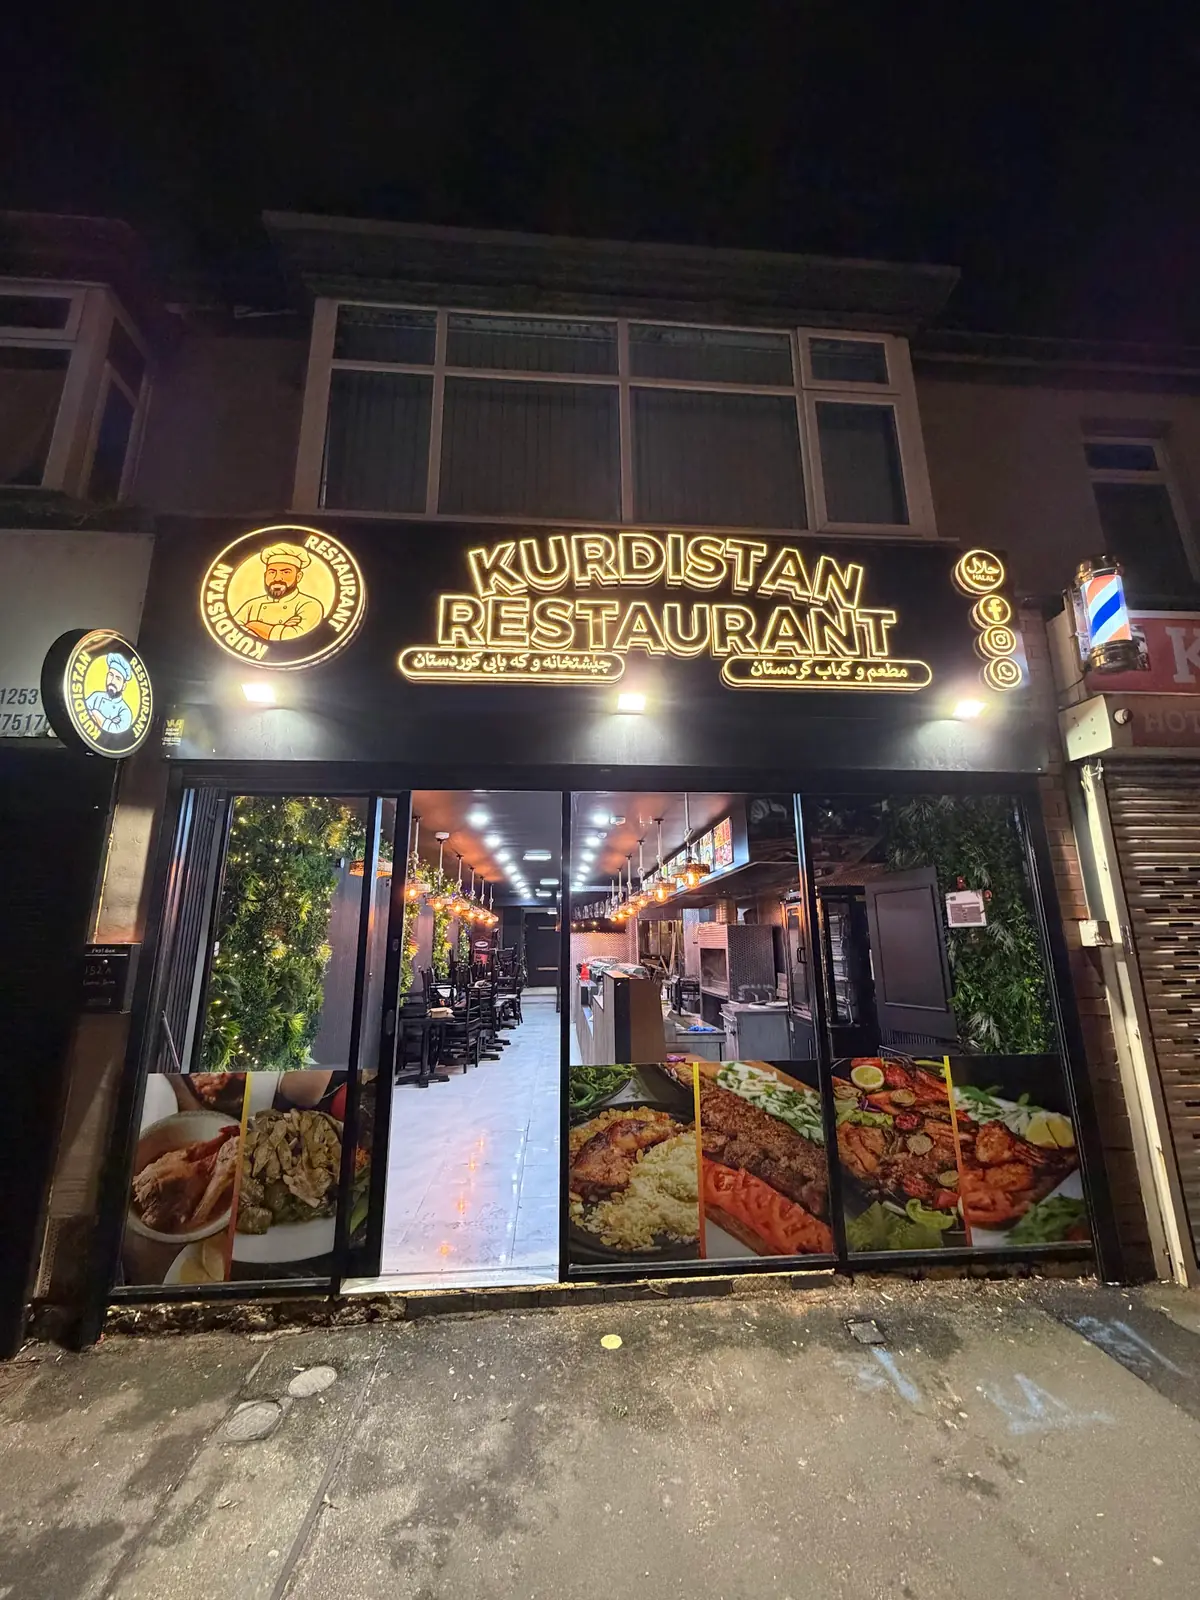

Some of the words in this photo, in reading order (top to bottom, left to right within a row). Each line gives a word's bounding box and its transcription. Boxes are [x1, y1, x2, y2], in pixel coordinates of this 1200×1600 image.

[304, 534, 357, 633] RESTAURANT
[468, 532, 864, 609] KURDISTAN
[966, 557, 1000, 574] حلال
[972, 574, 996, 583] HALAL
[206, 563, 270, 661] KURDISTAN
[437, 594, 898, 659] RESTAURANT
[70, 650, 102, 741] KURDISTAN
[530, 656, 541, 672] و
[855, 665, 864, 680] و
[867, 663, 909, 683] مطعم
[129, 656, 151, 739] RESTAURANT
